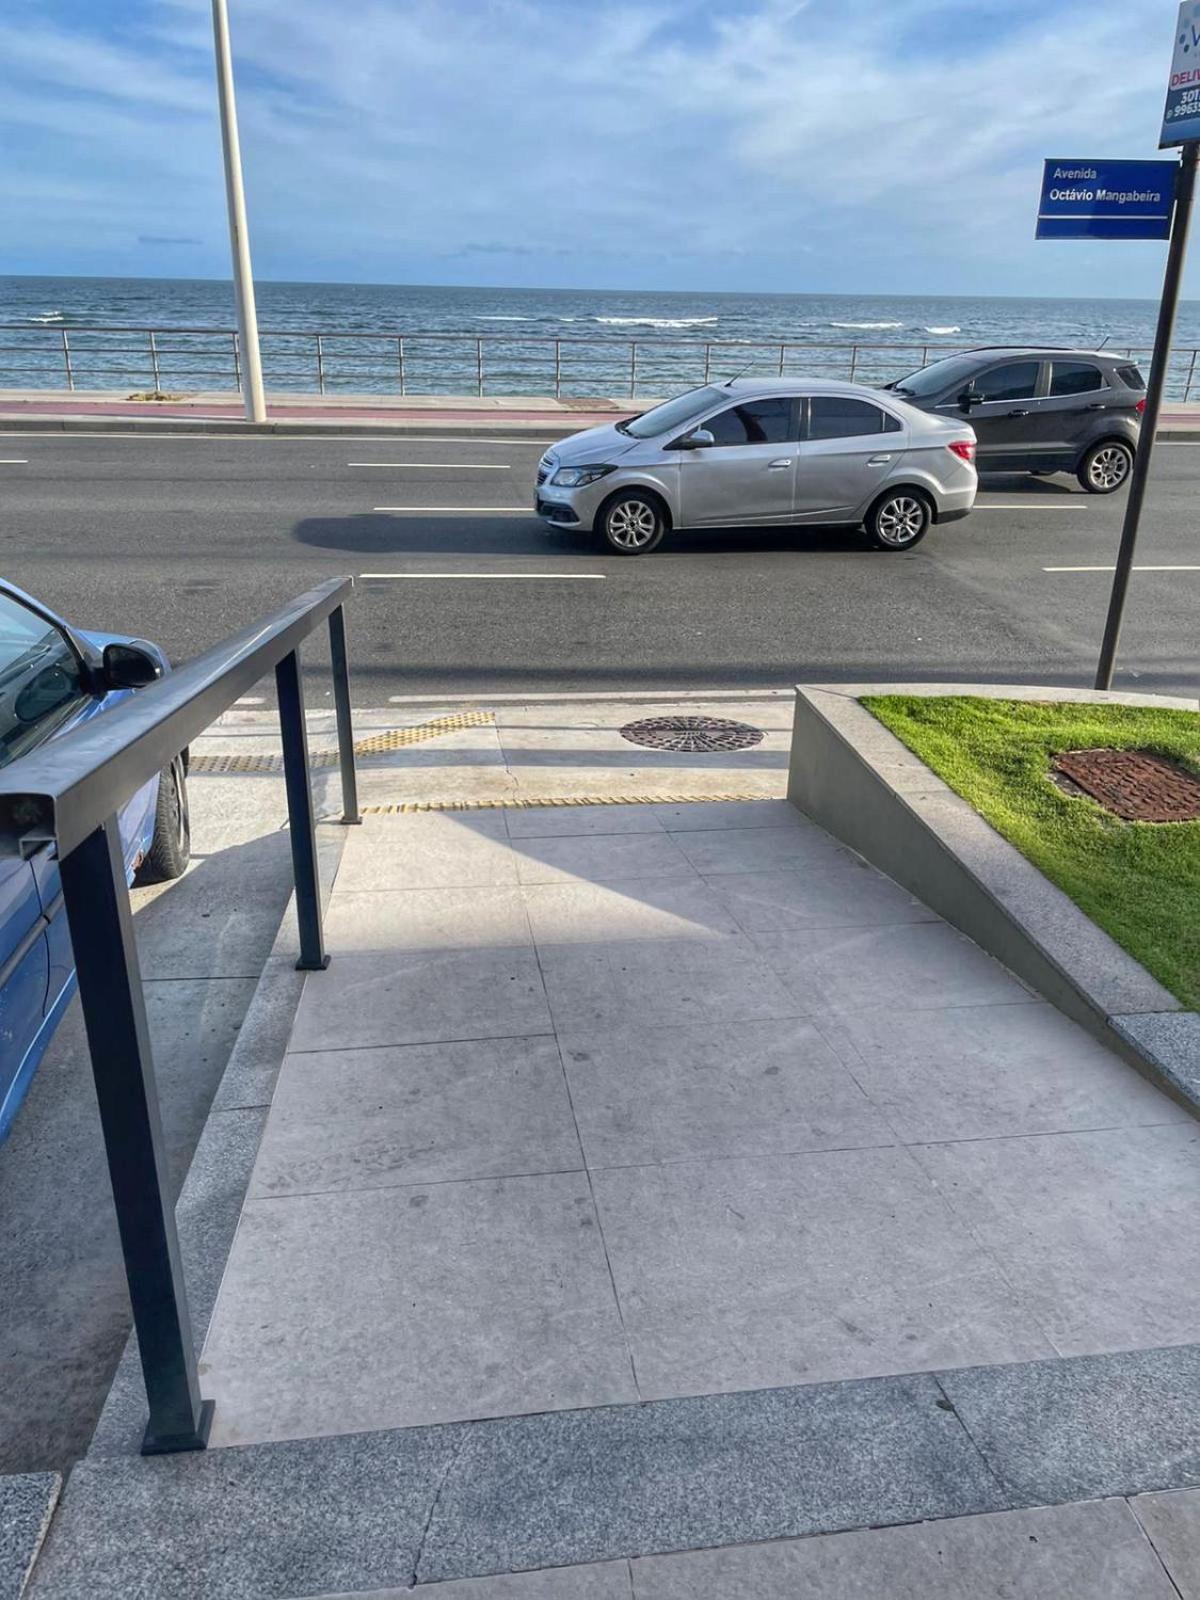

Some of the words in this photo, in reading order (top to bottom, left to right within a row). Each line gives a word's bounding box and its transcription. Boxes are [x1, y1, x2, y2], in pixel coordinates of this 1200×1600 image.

[1053, 168, 1097, 179] Avenida
[1049, 188, 1094, 201] Octávio
[1095, 189, 1161, 204] Mangabeira
